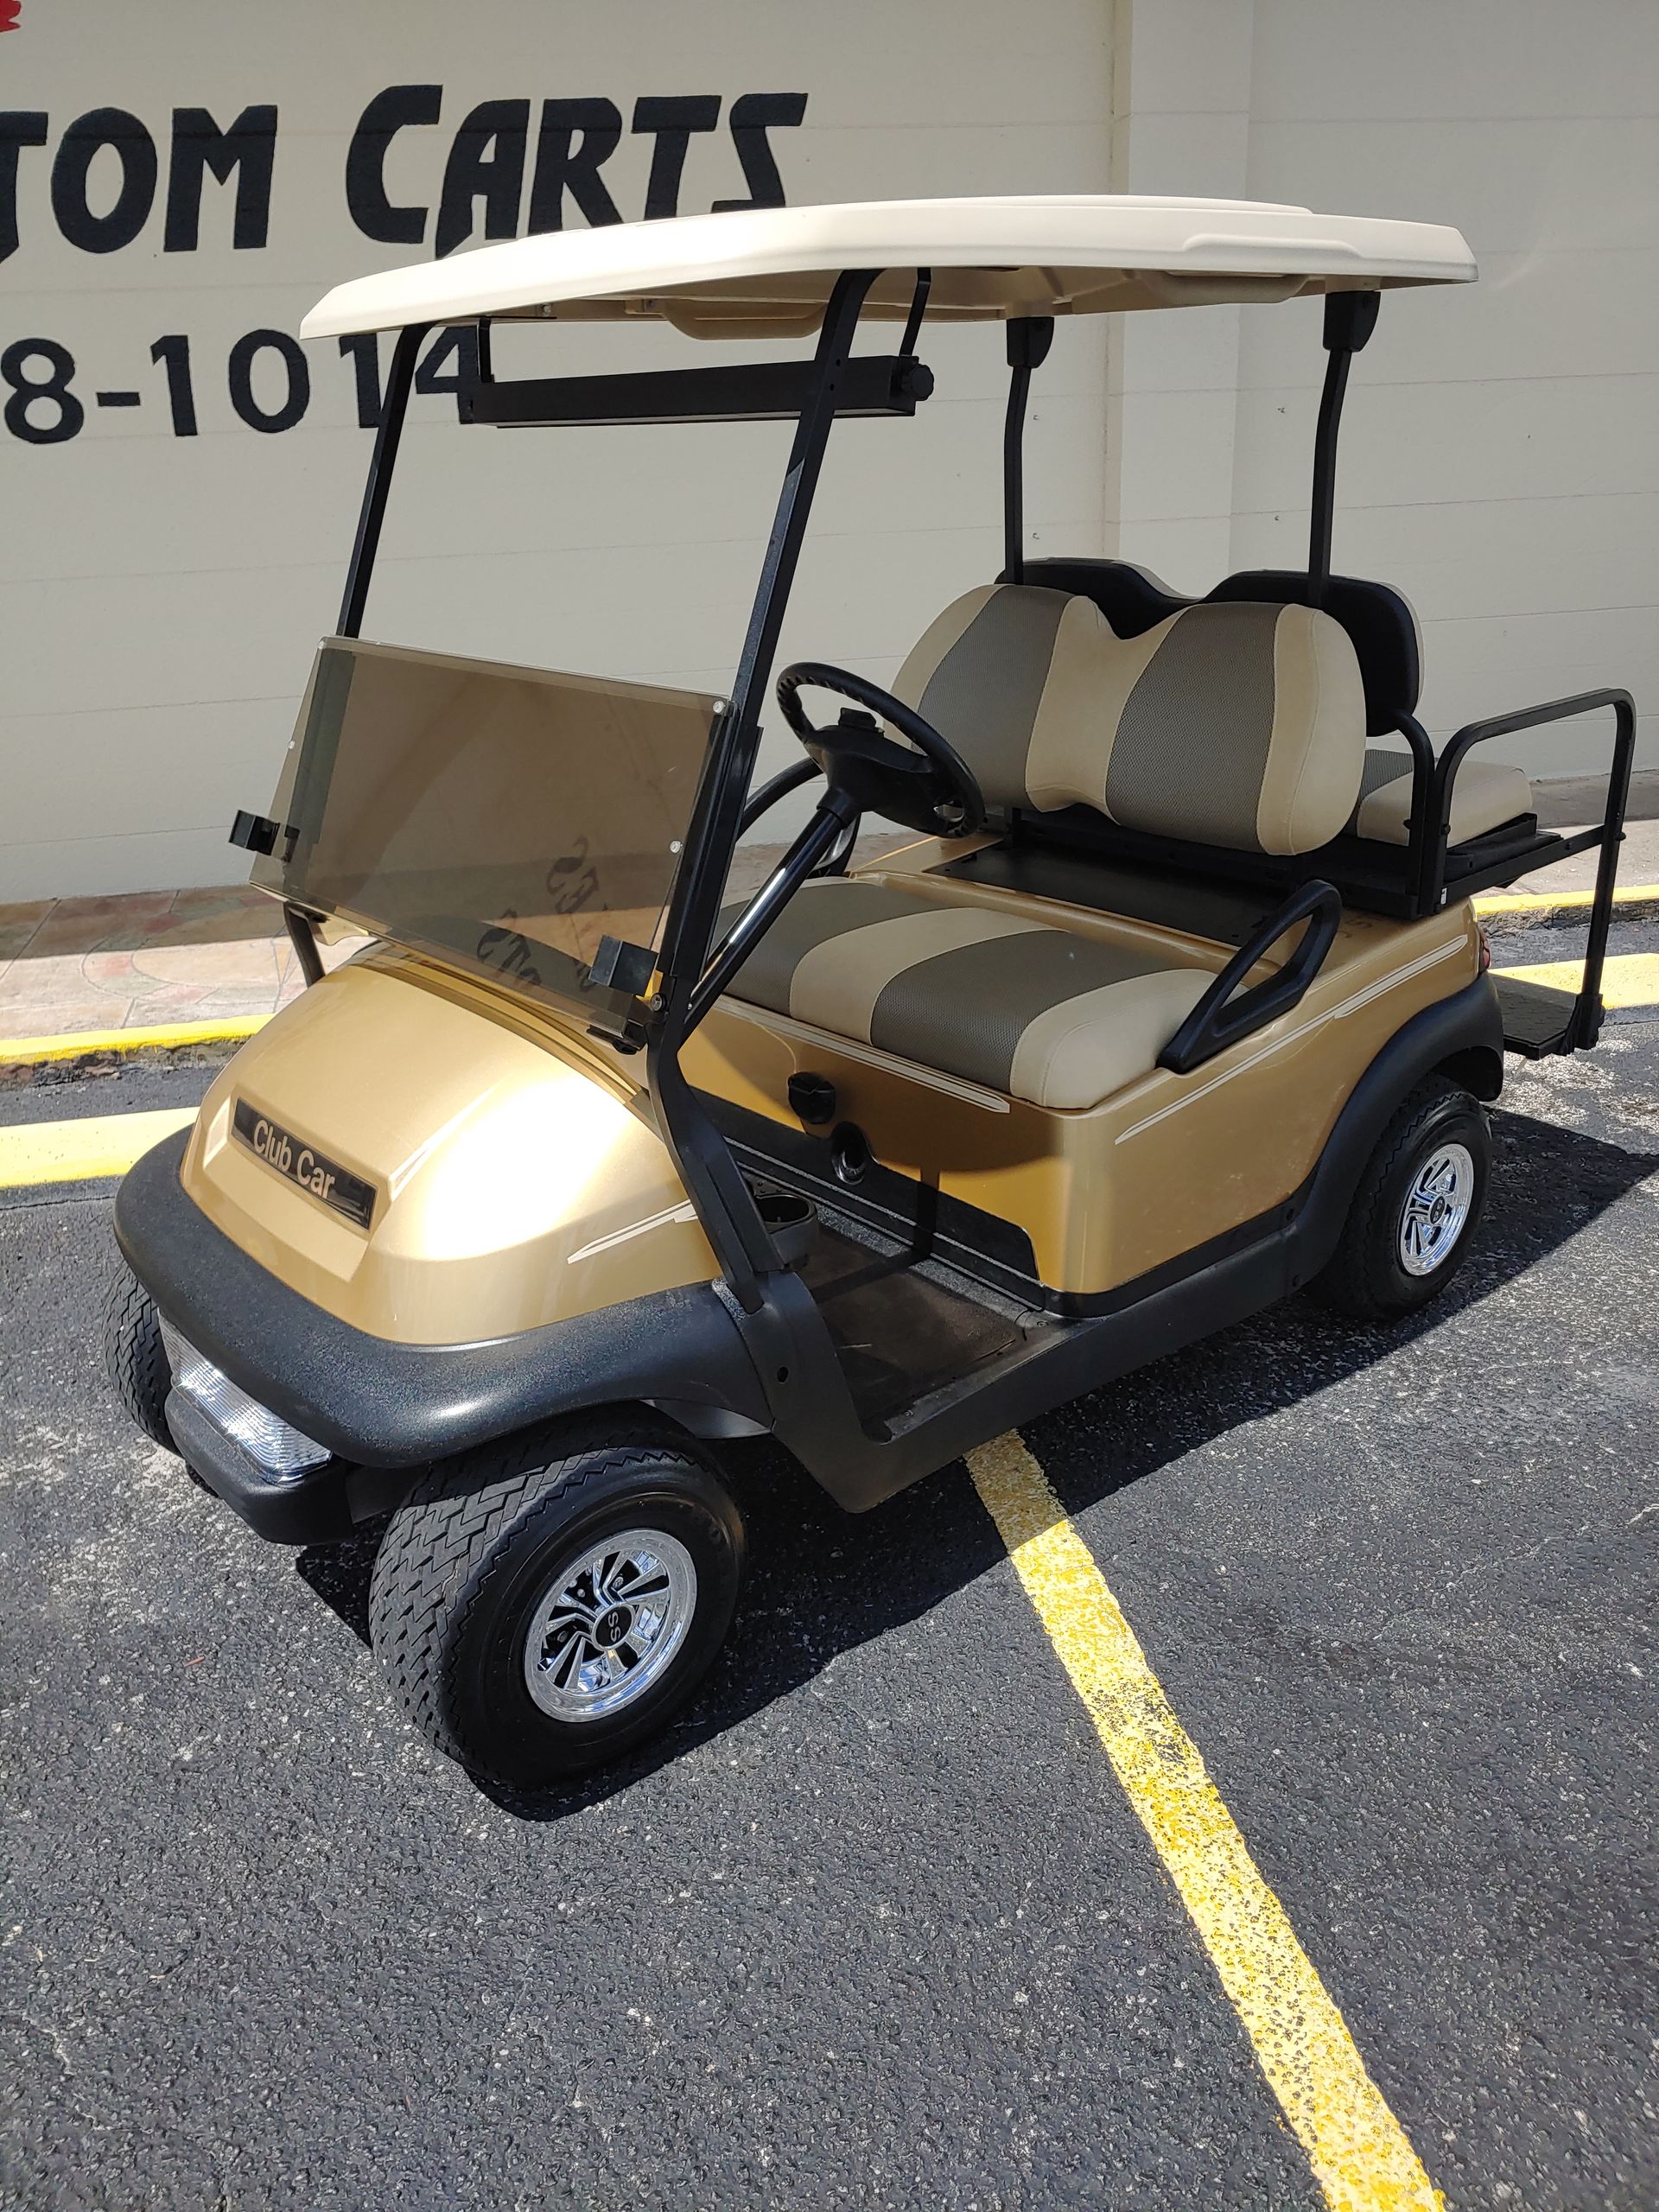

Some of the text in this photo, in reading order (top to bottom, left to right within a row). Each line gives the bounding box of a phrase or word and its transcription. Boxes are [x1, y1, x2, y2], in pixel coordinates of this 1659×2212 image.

[346, 84, 809, 261] CARTS
[0, 328, 481, 444] 8-1014
[253, 1119, 336, 1199] Club Car
[607, 1611, 621, 1643] SS
